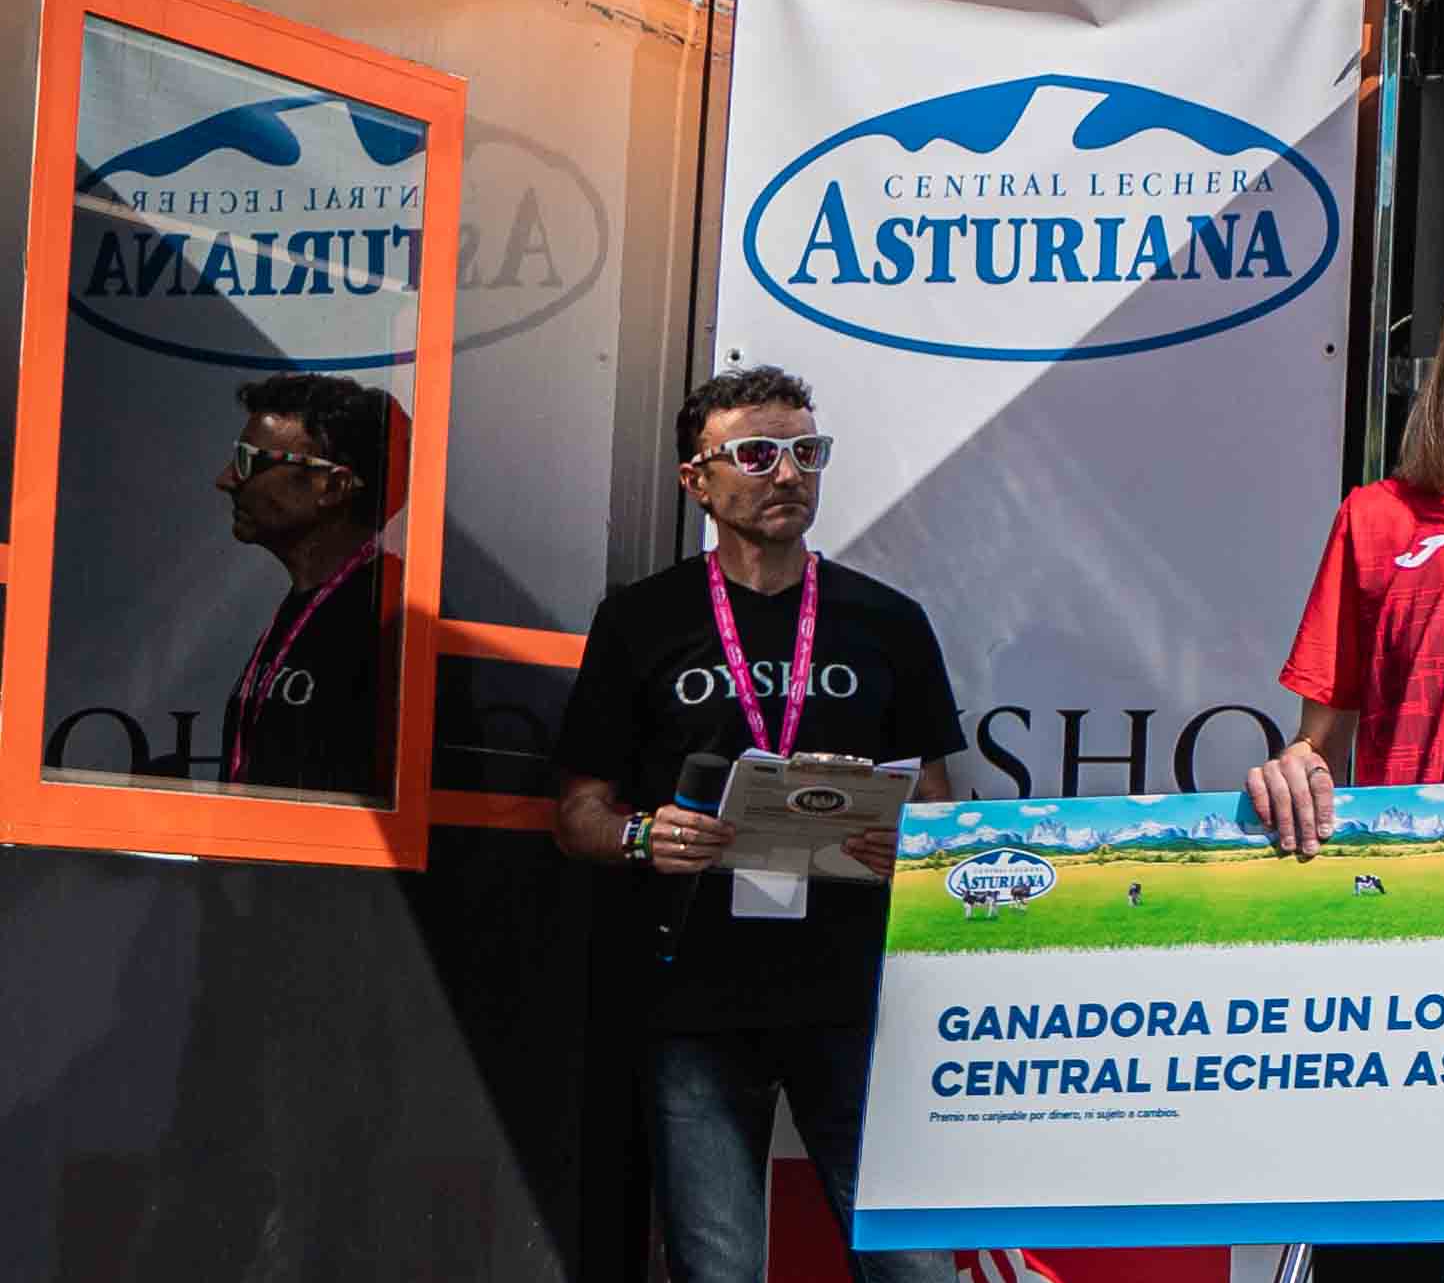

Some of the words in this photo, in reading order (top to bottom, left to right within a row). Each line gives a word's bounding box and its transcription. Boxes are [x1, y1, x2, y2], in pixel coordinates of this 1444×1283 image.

[884, 174, 1068, 199] CENTRAL
[1090, 169, 1274, 197] LECHERA
[788, 180, 1293, 285] ASTURIANA
[957, 704, 1288, 801] SHO
[937, 999, 1211, 1042] GANADORA
[1226, 996, 1289, 1035] DE
[1304, 994, 1372, 1032] UN
[931, 1056, 1152, 1097] CENTRAL
[1166, 1050, 1389, 1093] LECHERA
